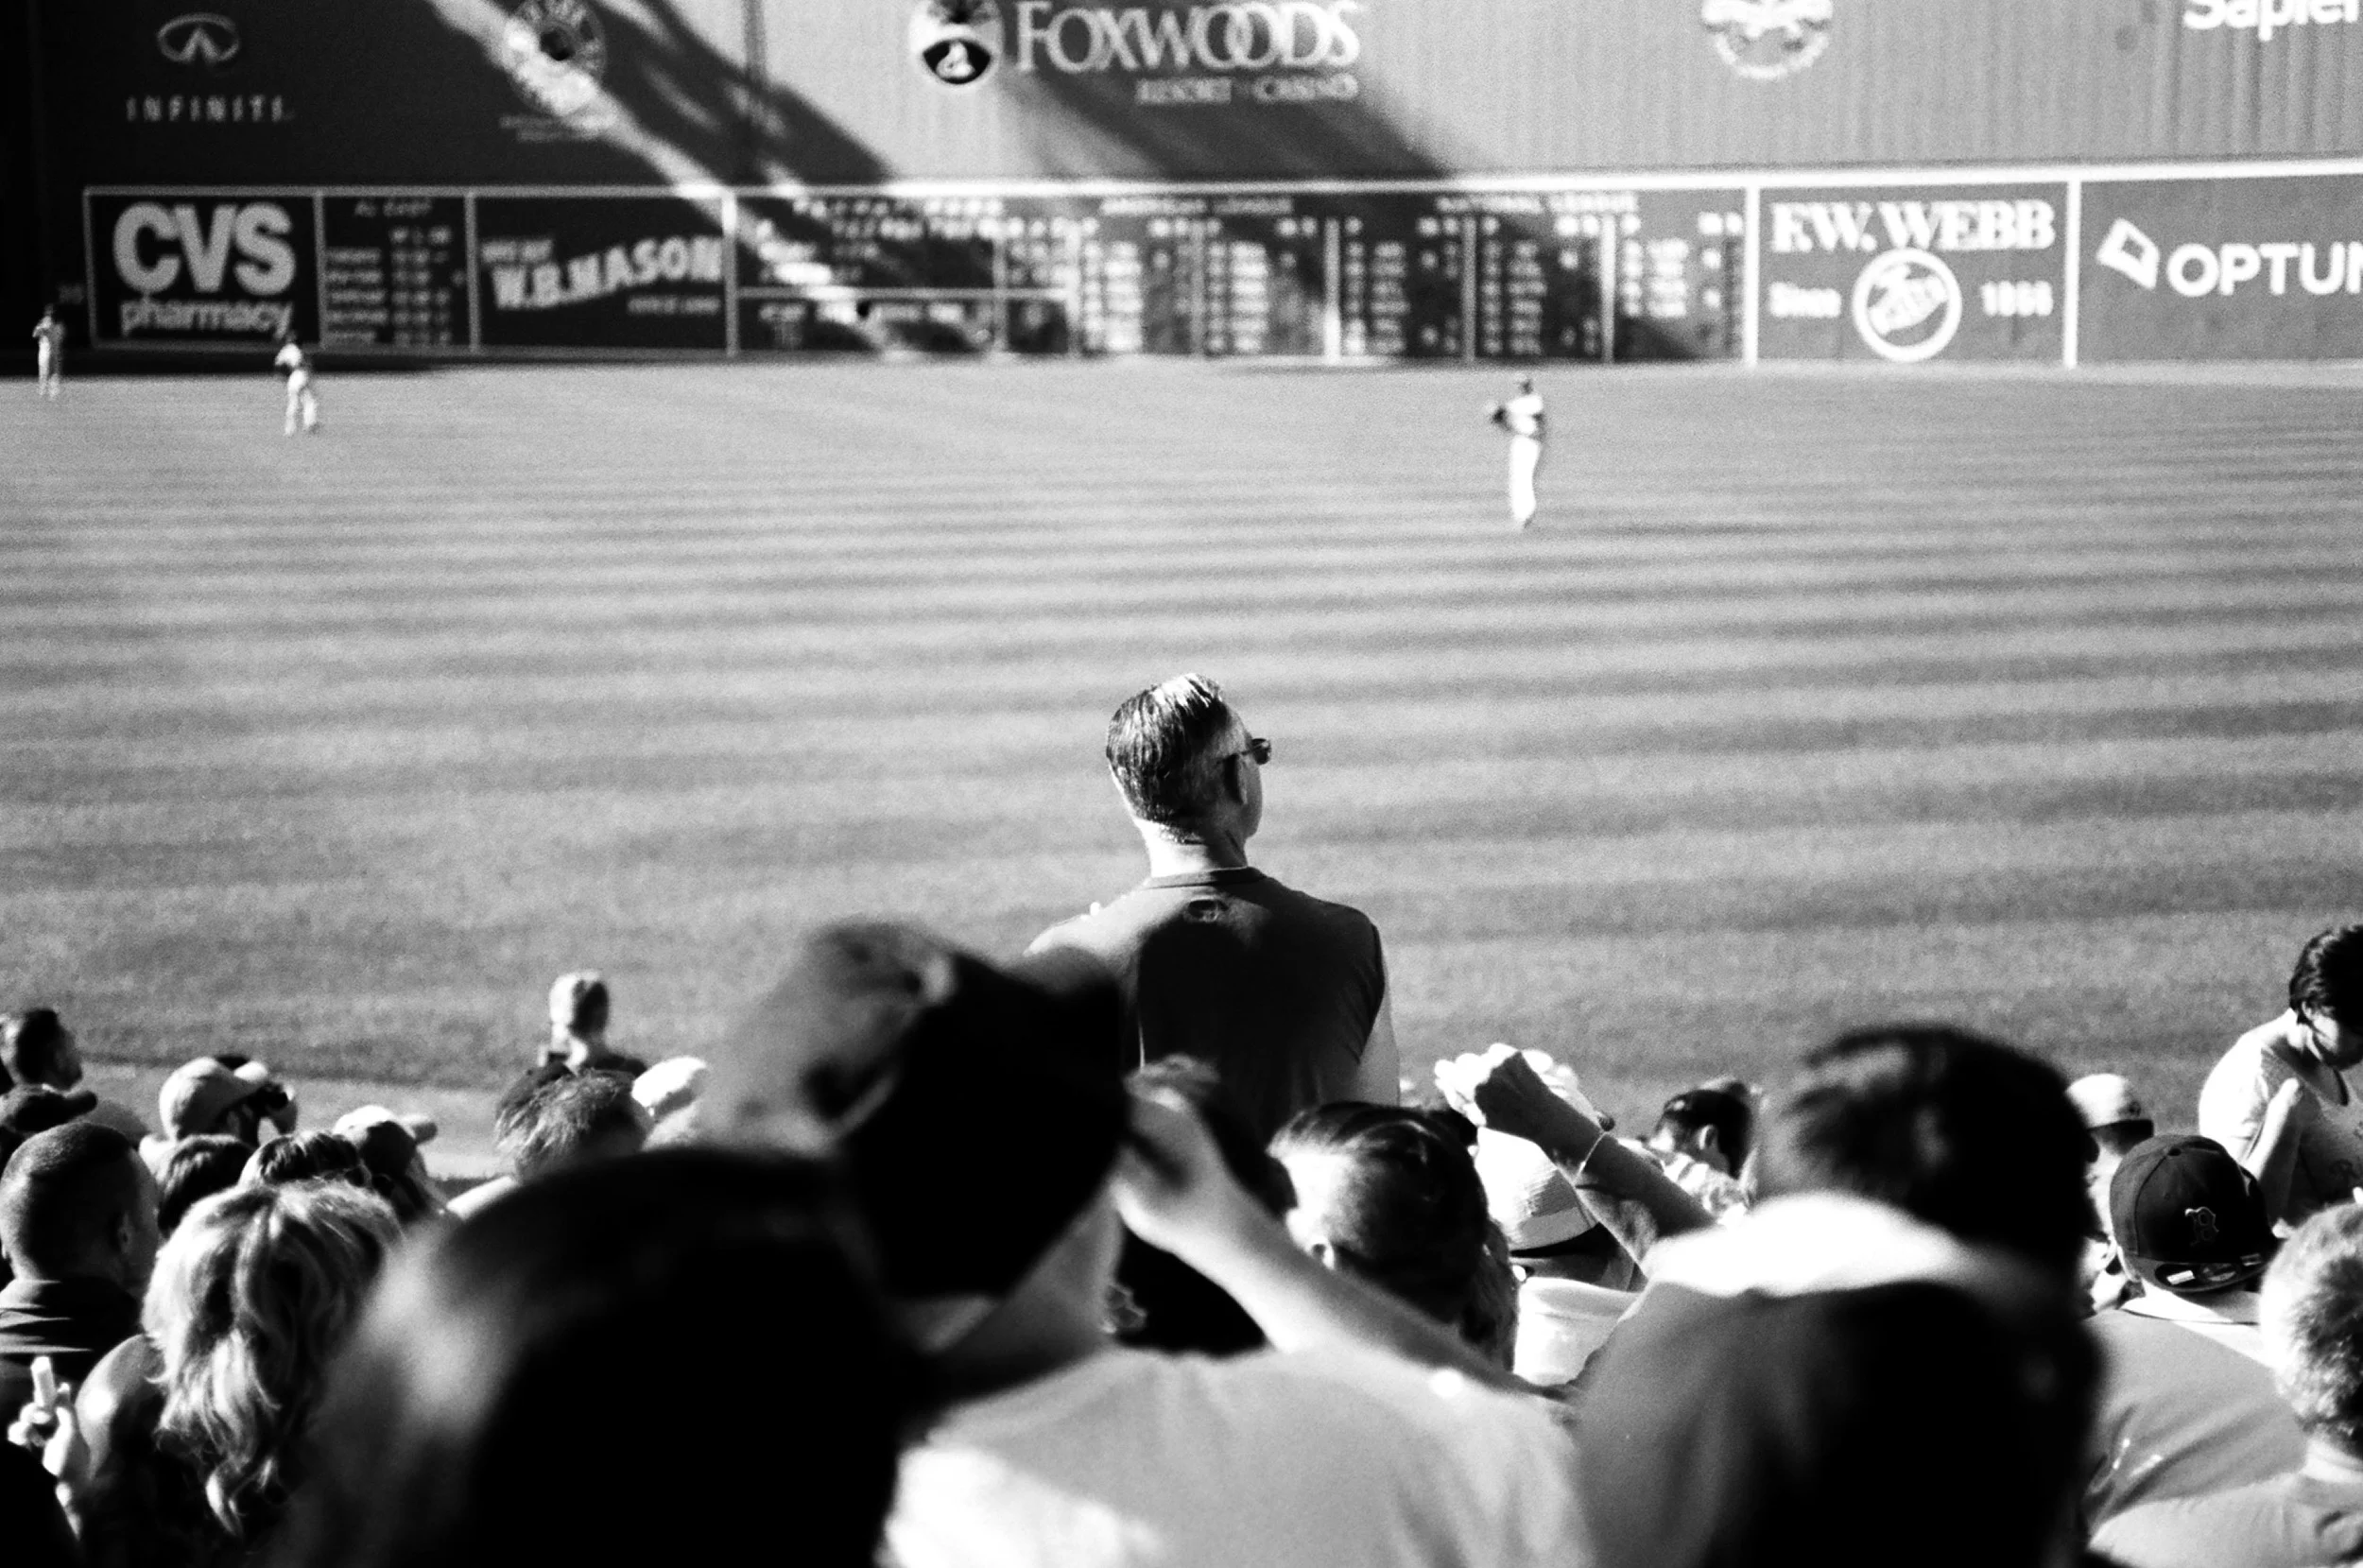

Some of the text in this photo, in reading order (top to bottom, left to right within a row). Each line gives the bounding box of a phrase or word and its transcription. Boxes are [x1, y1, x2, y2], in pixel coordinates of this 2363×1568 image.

[125, 94, 285, 123] INFINITI
[112, 201, 297, 297] CVS
[1877, 199, 2057, 250] WEBB
[120, 291, 294, 341] pharmacy
